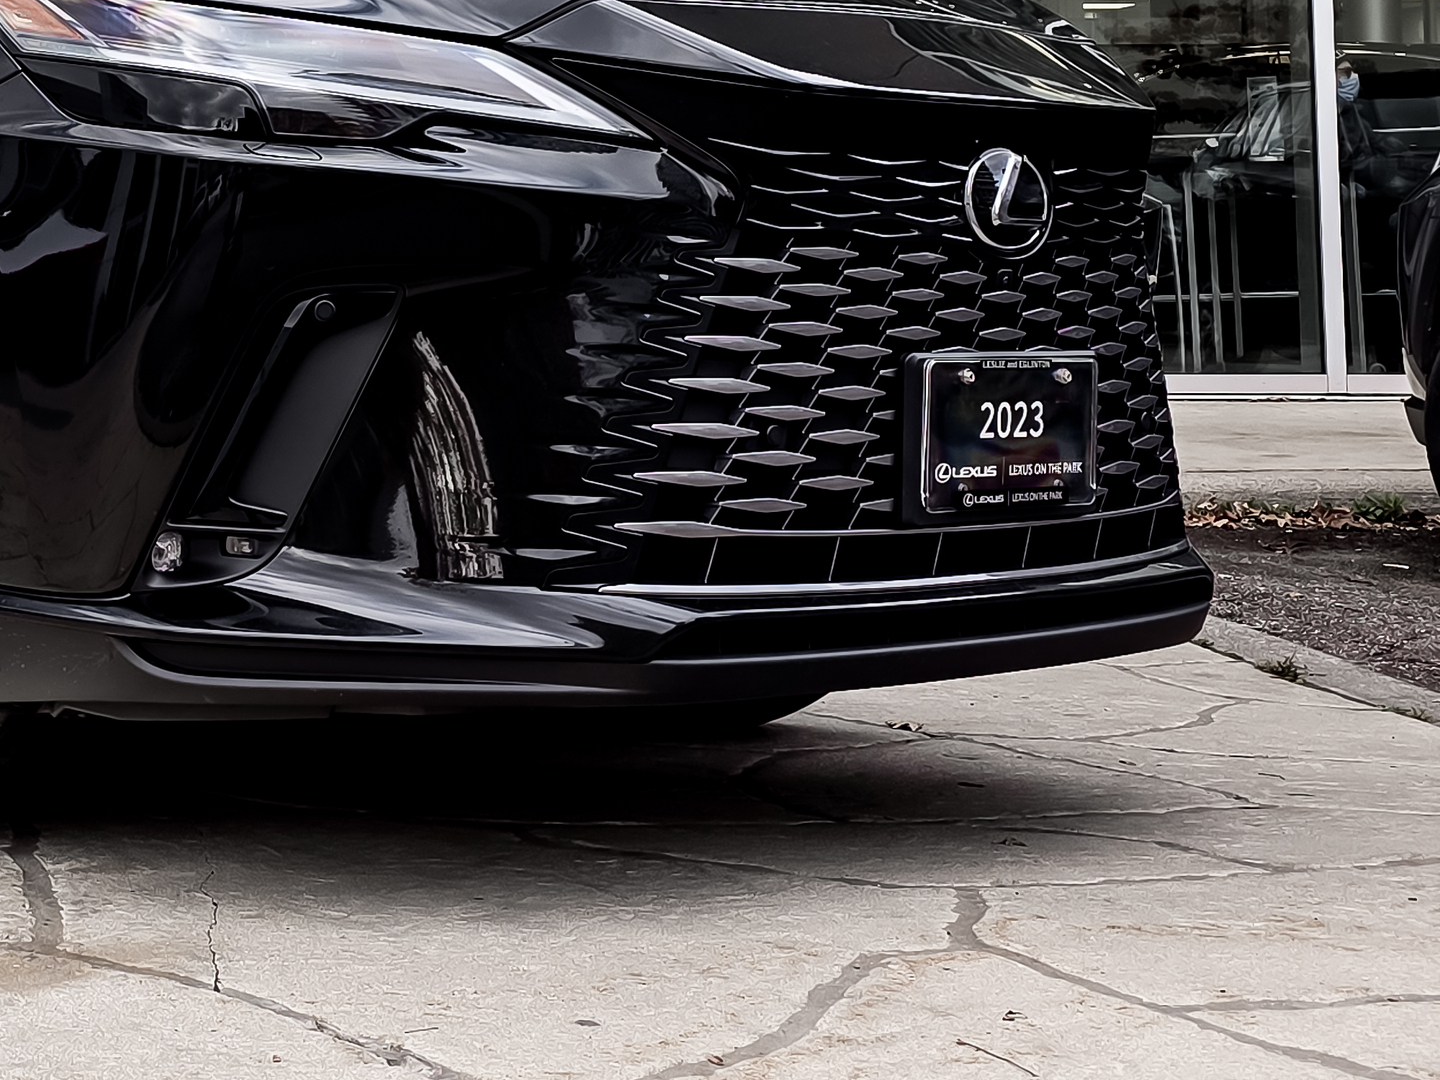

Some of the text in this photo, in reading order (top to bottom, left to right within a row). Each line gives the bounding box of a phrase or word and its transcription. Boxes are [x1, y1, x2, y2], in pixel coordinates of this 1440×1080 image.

[979, 400, 1045, 439] 2023
[952, 465, 998, 479] LEXUS
[1008, 461, 1083, 476] LEXUS ON THE PARK
[974, 494, 1005, 504] LEXUS
